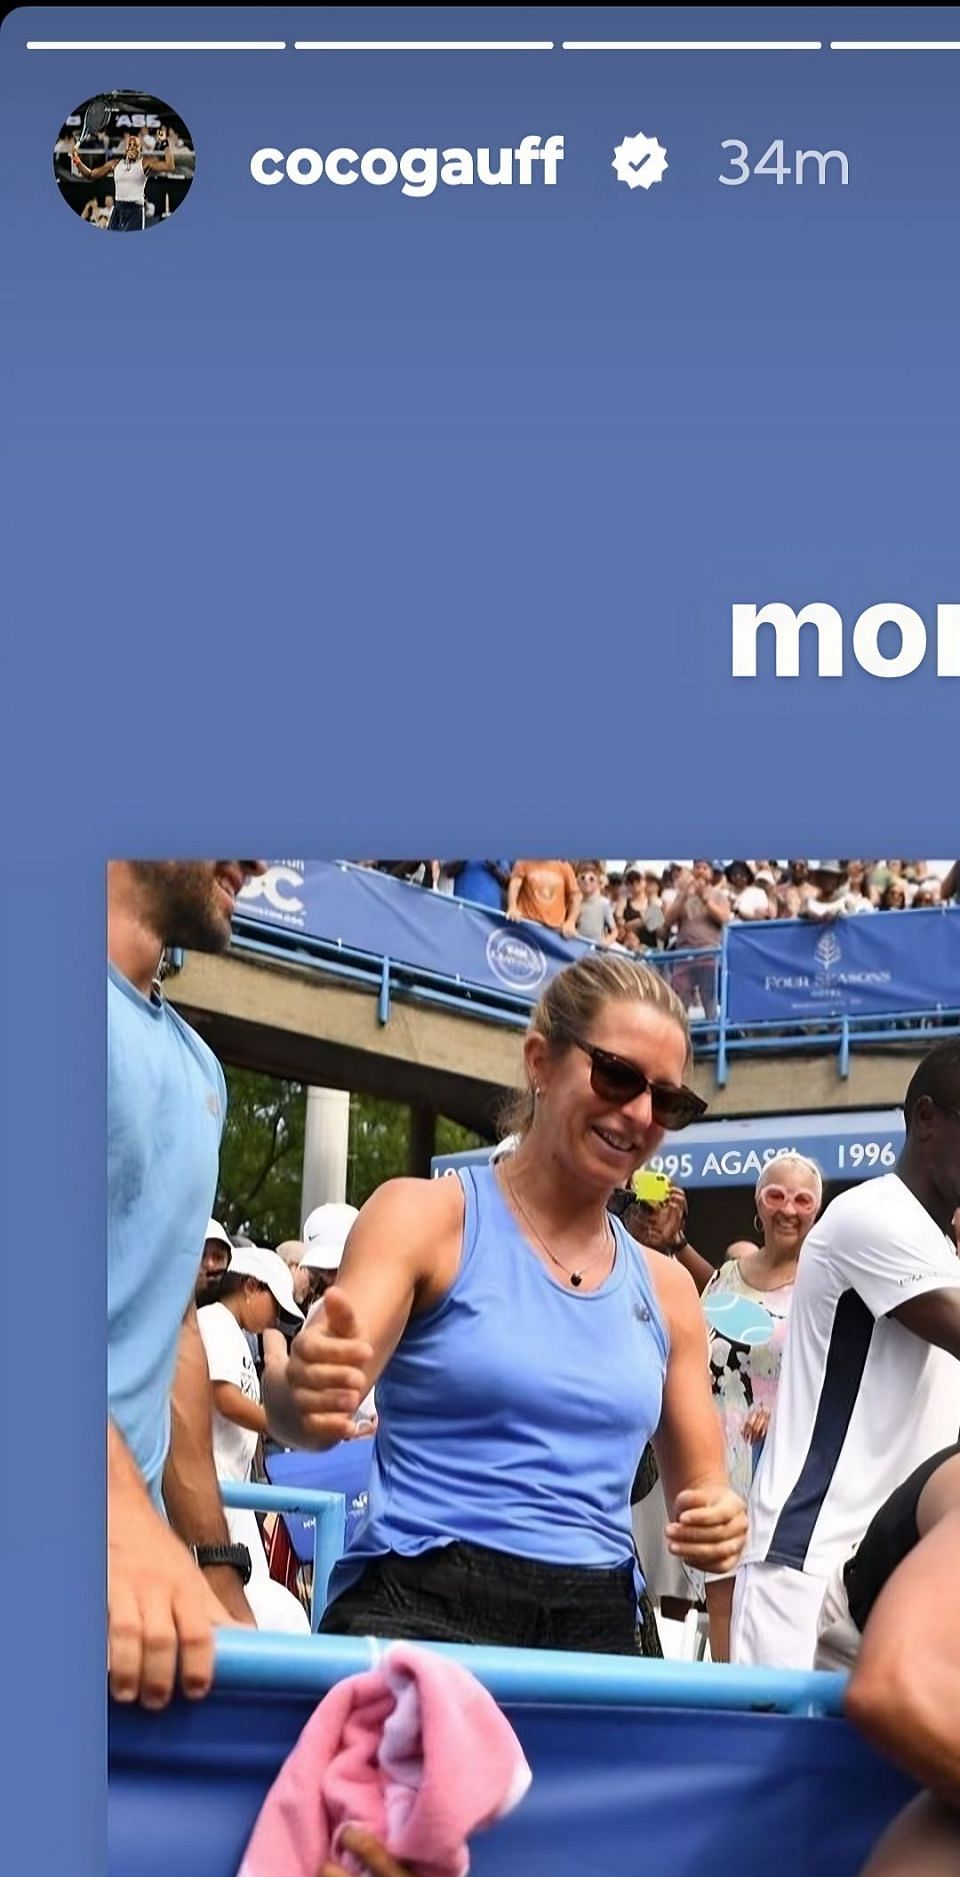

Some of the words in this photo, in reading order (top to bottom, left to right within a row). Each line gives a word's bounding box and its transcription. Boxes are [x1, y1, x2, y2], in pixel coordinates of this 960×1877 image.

[765, 975, 810, 990] FOUR
[650, 1153, 694, 1178] 995
[838, 1142, 896, 1168] 1996
